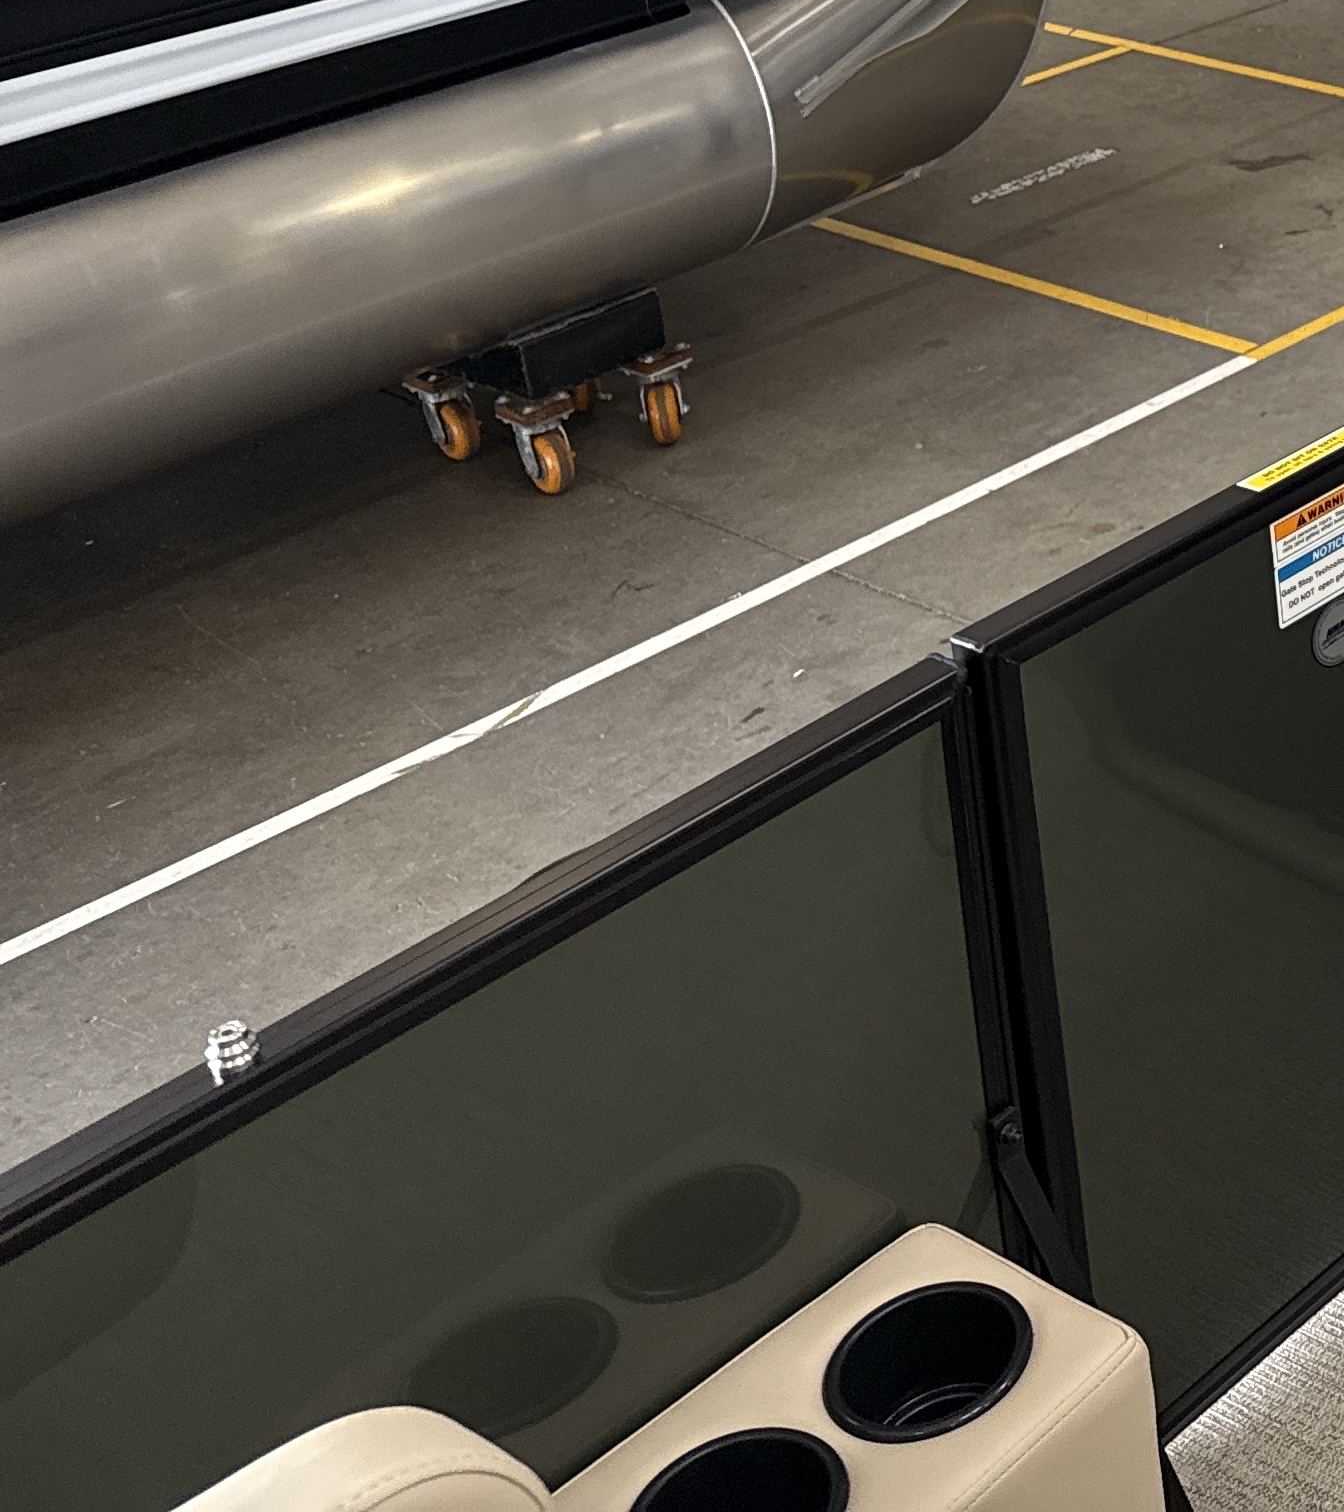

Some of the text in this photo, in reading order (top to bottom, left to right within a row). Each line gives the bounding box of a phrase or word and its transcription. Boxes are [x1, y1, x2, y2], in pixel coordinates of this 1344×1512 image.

[1281, 585, 1297, 598] Gate
[1297, 575, 1314, 589] Stop
[1288, 597, 1300, 609] DO
[1300, 587, 1316, 602] NOT
[1317, 578, 1335, 592] open
